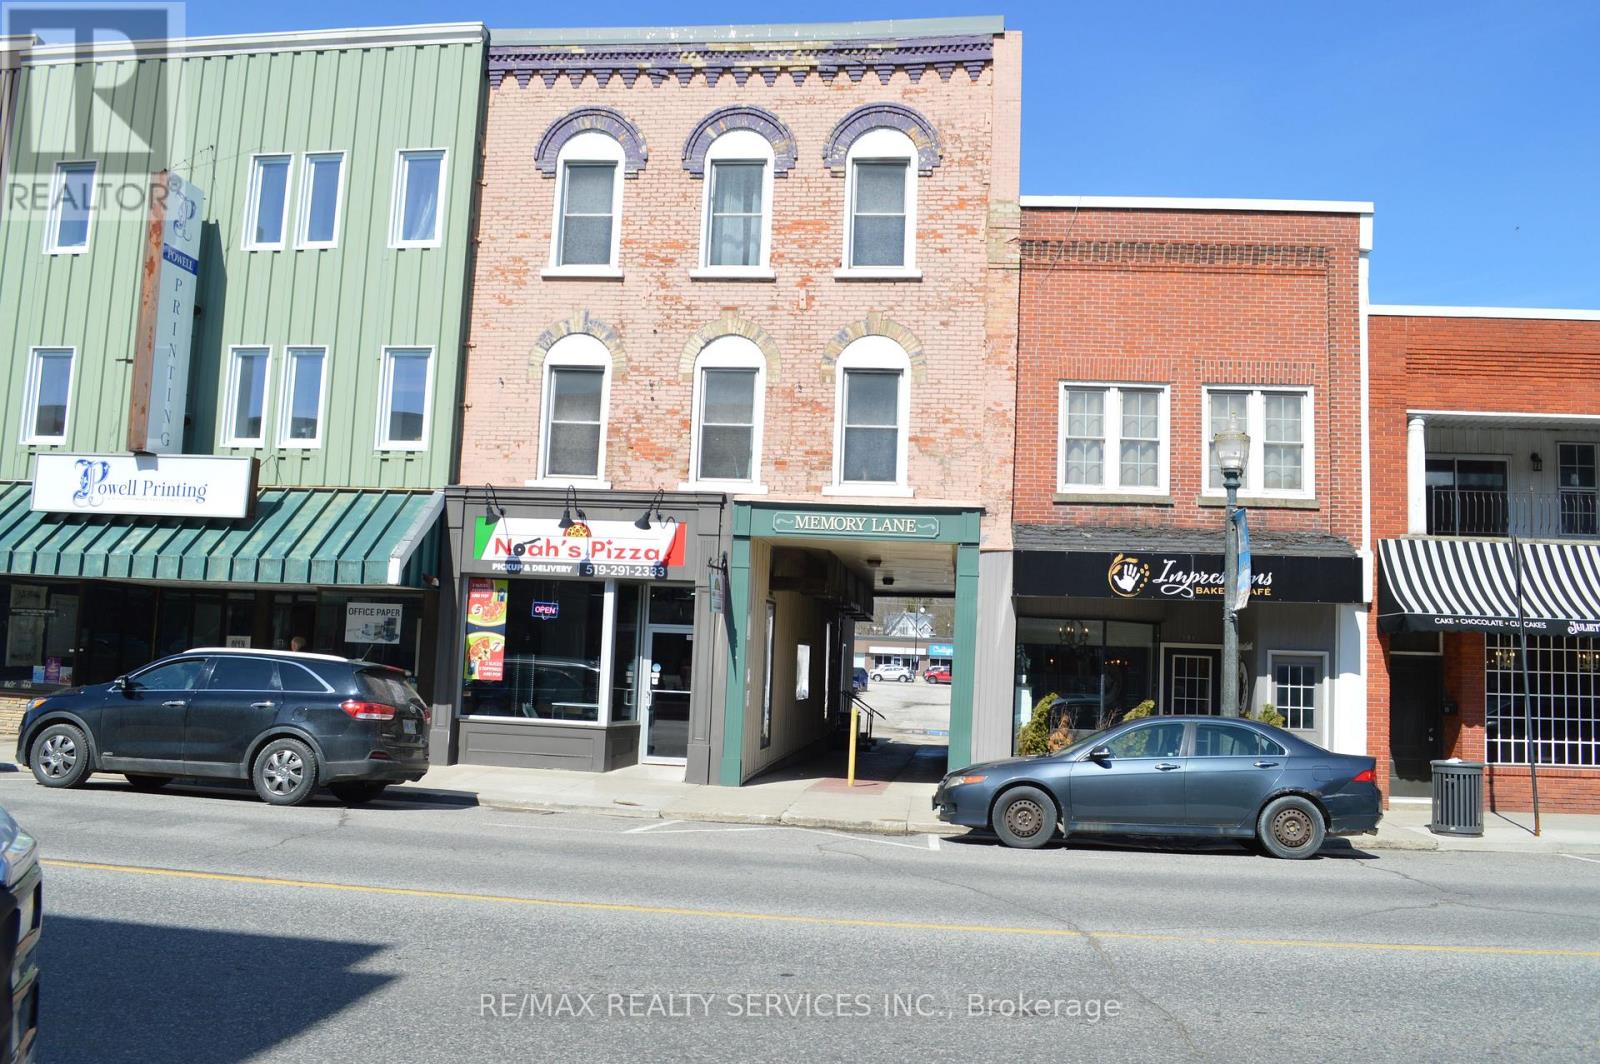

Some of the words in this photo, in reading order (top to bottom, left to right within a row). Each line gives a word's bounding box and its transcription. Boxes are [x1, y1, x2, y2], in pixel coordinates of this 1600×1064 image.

[161, 277, 183, 448] PRINTING
[73, 459, 137, 507] Powell
[143, 480, 208, 504] Printing
[794, 515, 867, 532] MEMORY
[872, 518, 917, 533] LANE
[494, 537, 581, 558] Noah's
[591, 540, 659, 561] Pizza
[492, 563, 522, 572] PICKUP
[523, 564, 531, 572] &
[532, 564, 572, 573] DELIVERY
[1152, 559, 1273, 598] Impresns
[1195, 586, 1225, 595] BAKE
[348, 607, 375, 617] OFFICE
[376, 608, 400, 618] PAPER
[534, 605, 556, 614] OPEN
[1434, 617, 1455, 625] CAKE
[1460, 618, 1504, 627] CHOCOLATE
[1509, 620, 1547, 629] CUCAKES
